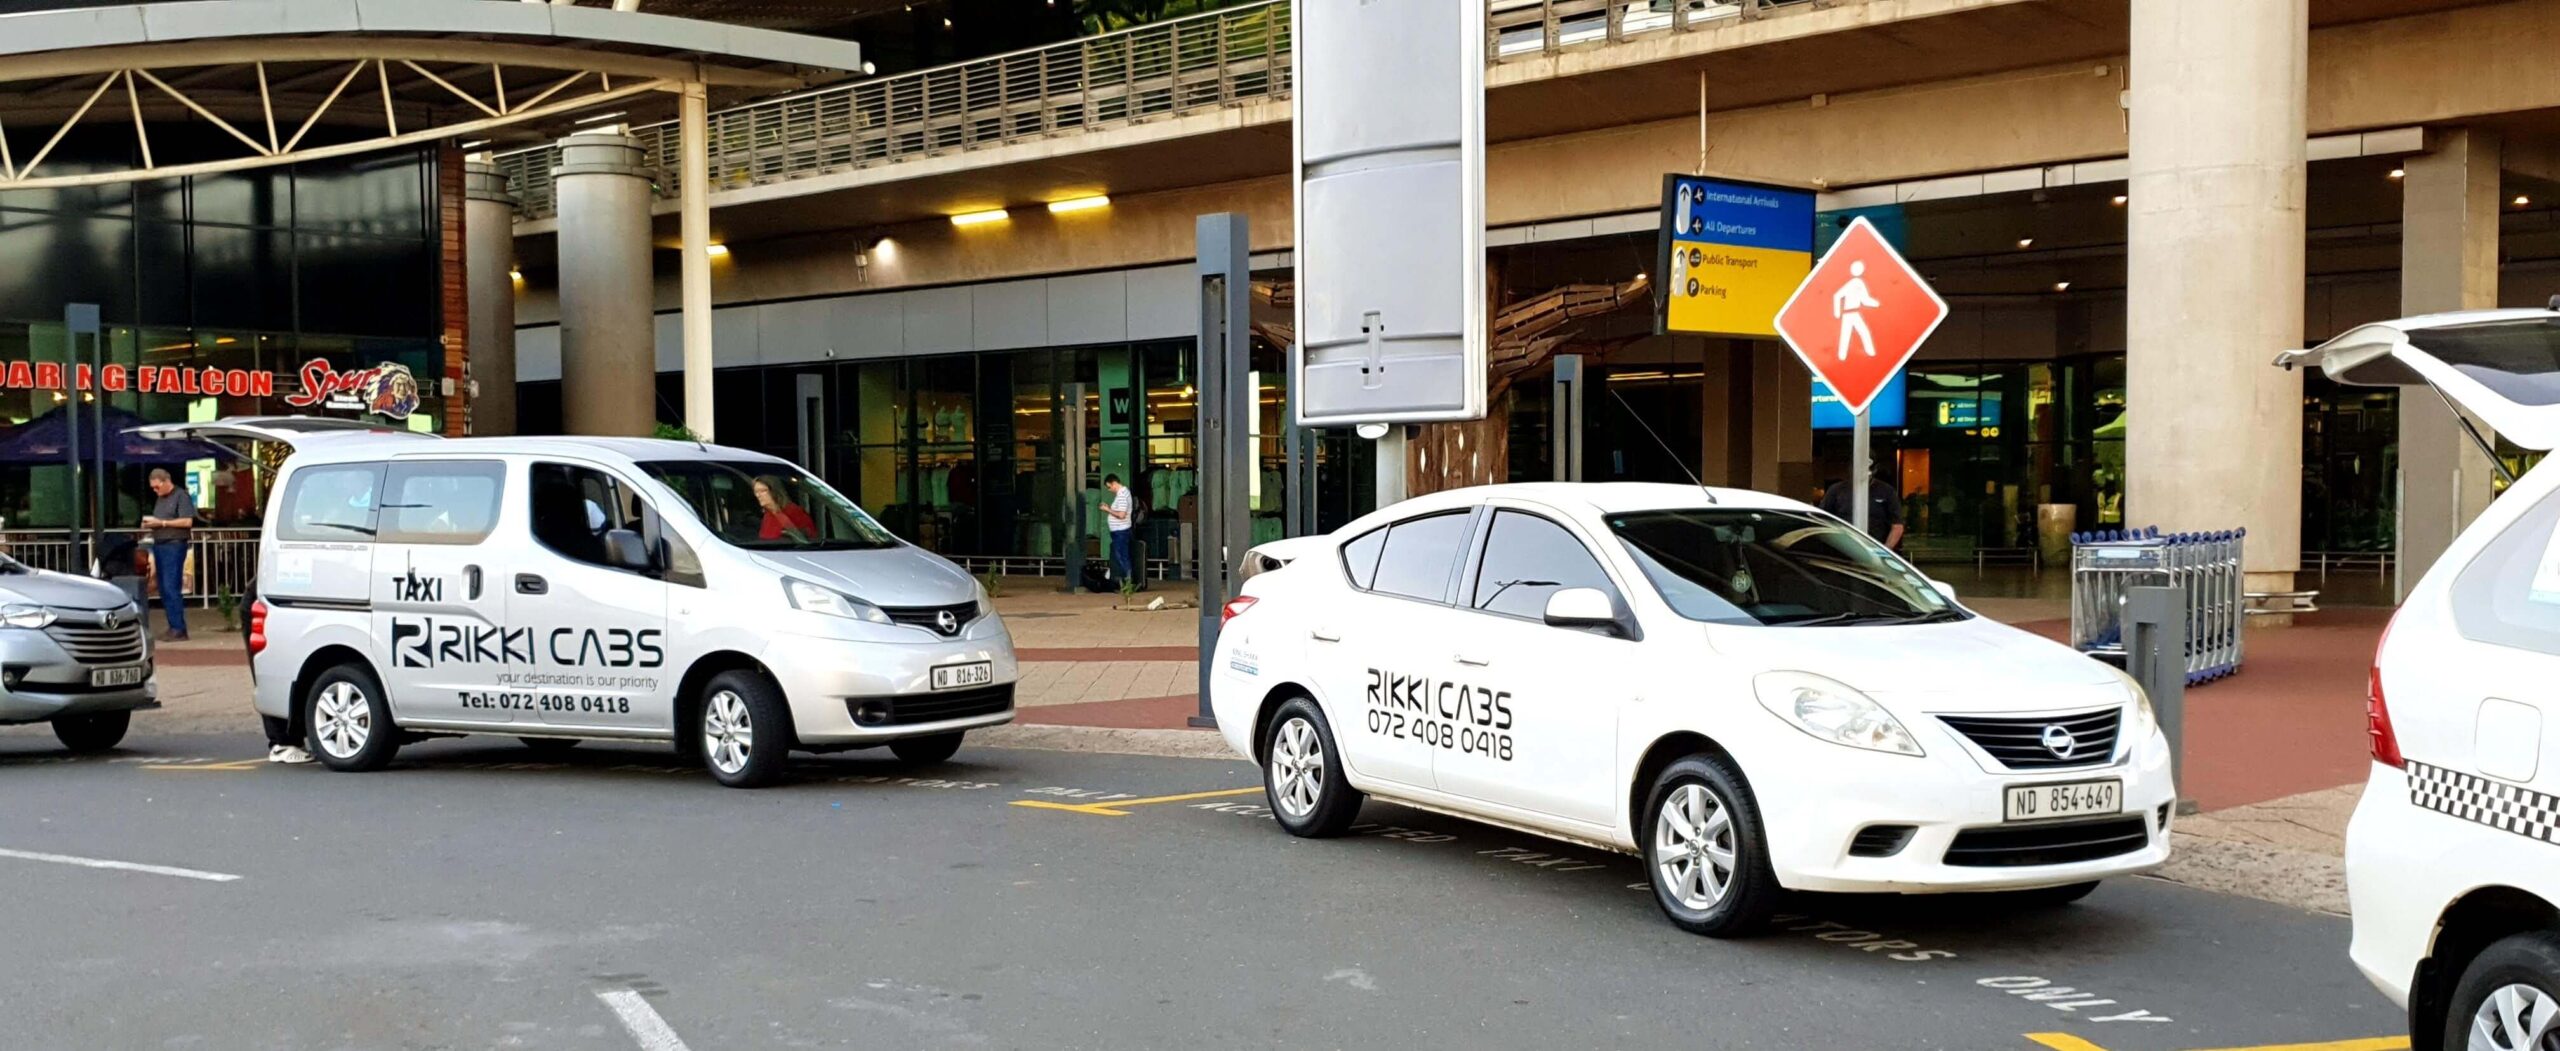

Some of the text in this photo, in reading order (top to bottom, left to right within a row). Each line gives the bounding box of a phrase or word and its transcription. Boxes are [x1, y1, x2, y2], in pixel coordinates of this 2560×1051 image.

[1706, 190, 1779, 209] International Arrivals
[1705, 221, 1756, 236] All Departures
[1702, 253, 1758, 269] Public Transport
[1700, 284, 1727, 299] Parking
[138, 365, 273, 397] FALCON
[285, 358, 383, 406] Spur
[392, 573, 442, 602] TAXI
[439, 625, 536, 665] RIKKI
[550, 627, 664, 669] CABS
[496, 671, 659, 692] your destination is our priority
[937, 665, 989, 686] ND 816-326
[458, 692, 630, 714] Tel: 072 408 0418
[1367, 667, 1512, 730] RIKKI CABS
[1368, 708, 1513, 761] 072 408 0418
[2016, 785, 2113, 816] ND 854-649
[1976, 975, 2174, 1023] ONLY
